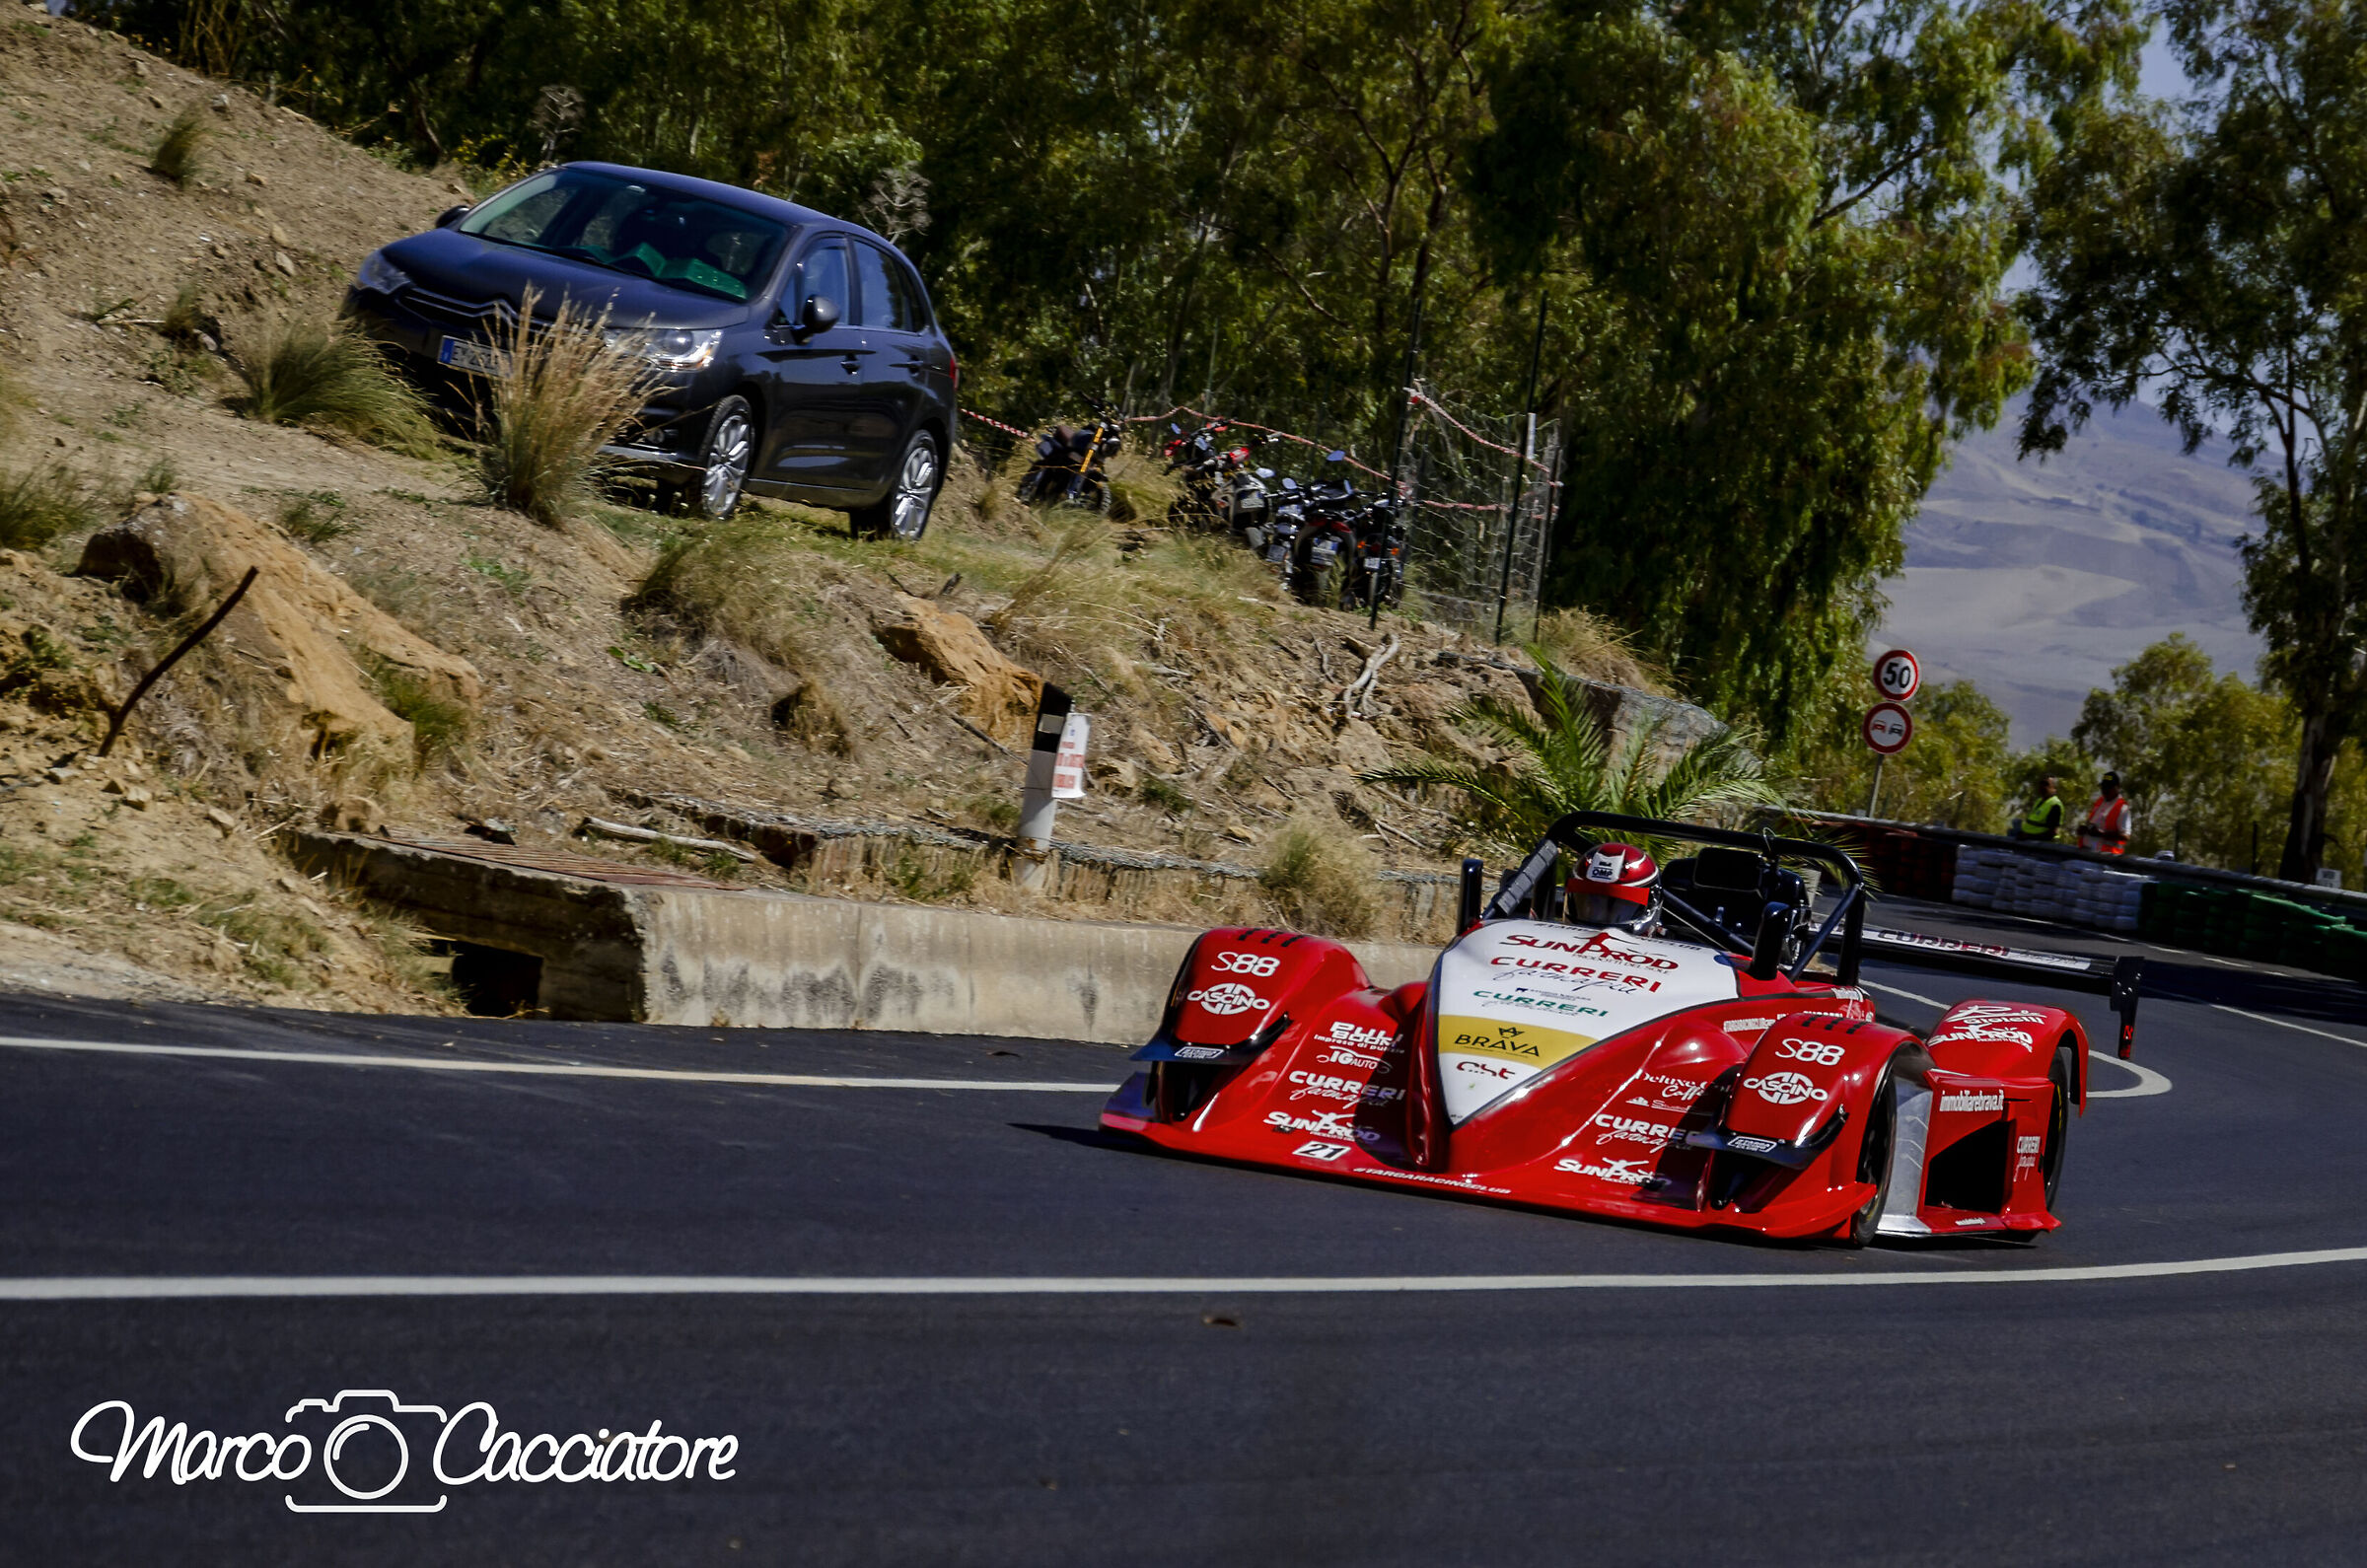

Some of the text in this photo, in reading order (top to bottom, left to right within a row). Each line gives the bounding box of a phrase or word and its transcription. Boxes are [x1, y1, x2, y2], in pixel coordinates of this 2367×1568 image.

[1883, 662, 1910, 688] 50
[1211, 952, 1281, 977] S88
[1490, 957, 1662, 993] CURRERI
[1187, 989, 1270, 1011] CASCINO
[1472, 990, 1611, 1017] CURRERI
[1454, 1033, 1540, 1057] BRAVA
[1775, 1038, 1845, 1066] S88
[1288, 1070, 1406, 1101] CURRERI
[1743, 1078, 1829, 1102] CASCINO
[1595, 1113, 1702, 1140] CURRE
[1297, 1143, 1345, 1159] 21
